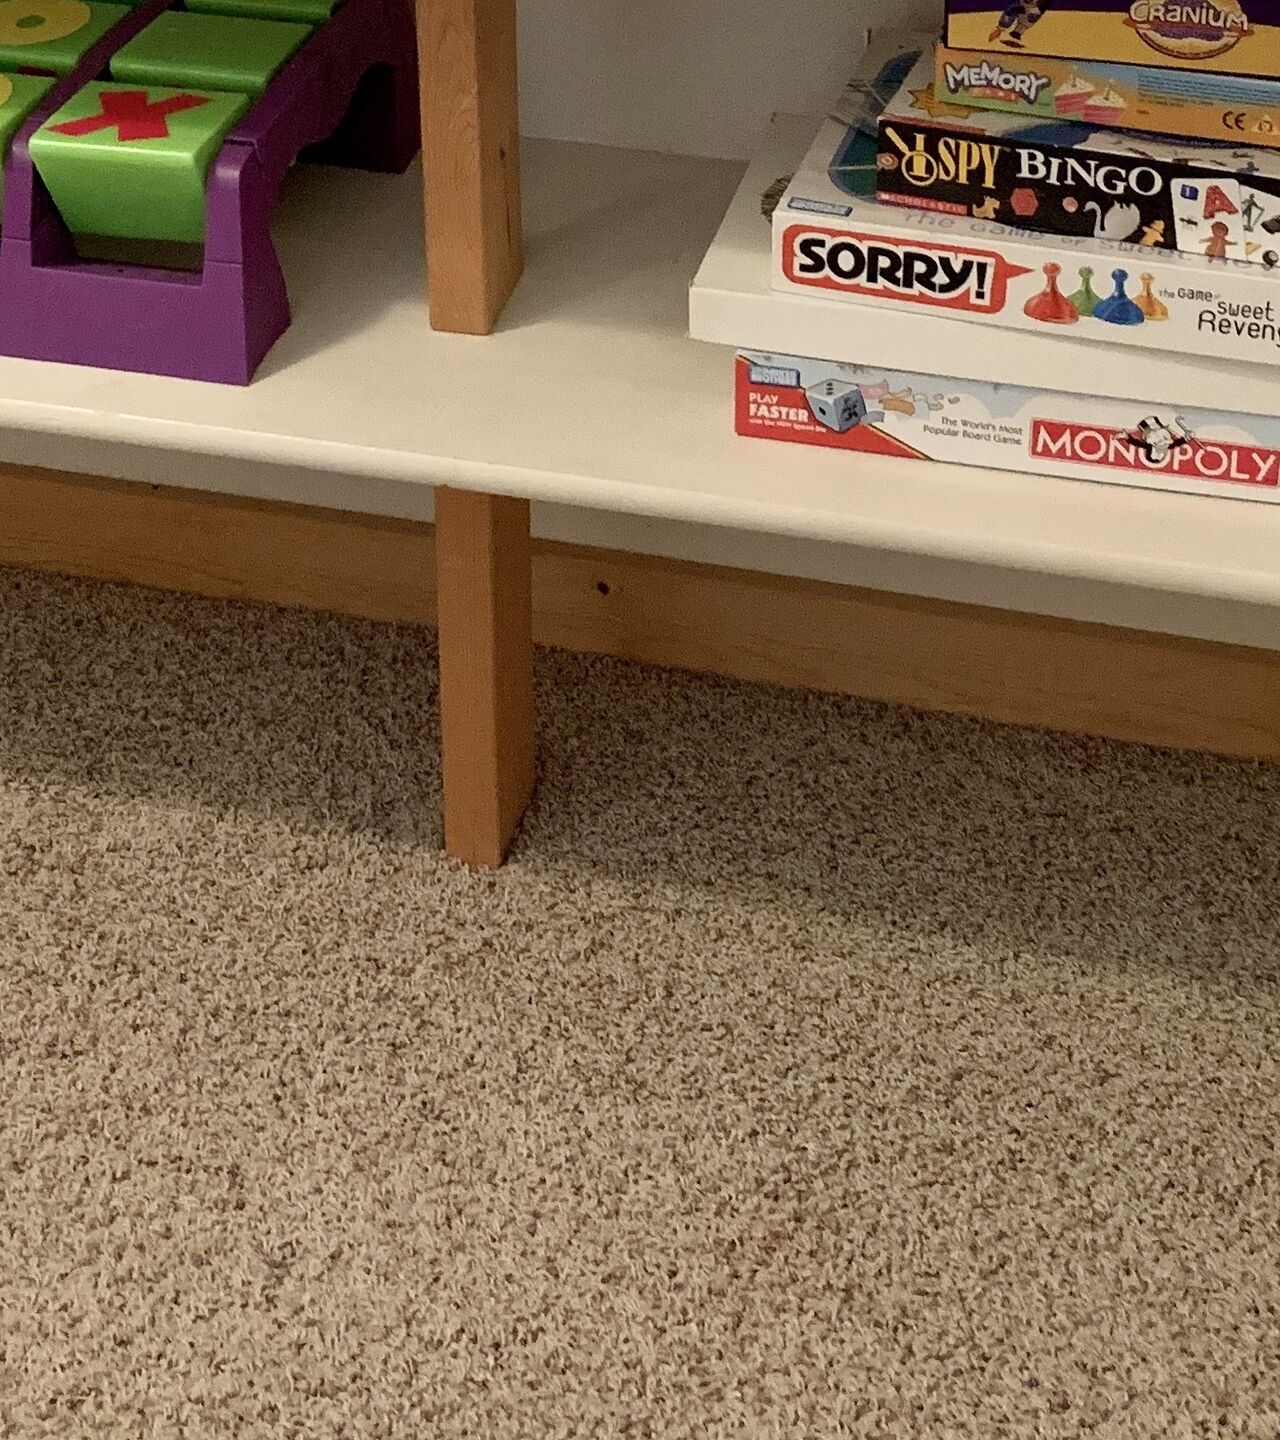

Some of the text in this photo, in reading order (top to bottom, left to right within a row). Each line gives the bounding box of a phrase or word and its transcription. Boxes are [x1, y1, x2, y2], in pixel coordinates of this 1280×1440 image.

[944, 60, 1051, 102] MEMORY
[938, 137, 1001, 188] SPY
[1016, 148, 1163, 195] BINGO
[798, 238, 988, 300] SORRY!
[1217, 301, 1274, 322] sweet
[749, 393, 779, 404] PLAY
[749, 403, 808, 422] FASTER
[1034, 428, 1277, 482] MONOPOLY
